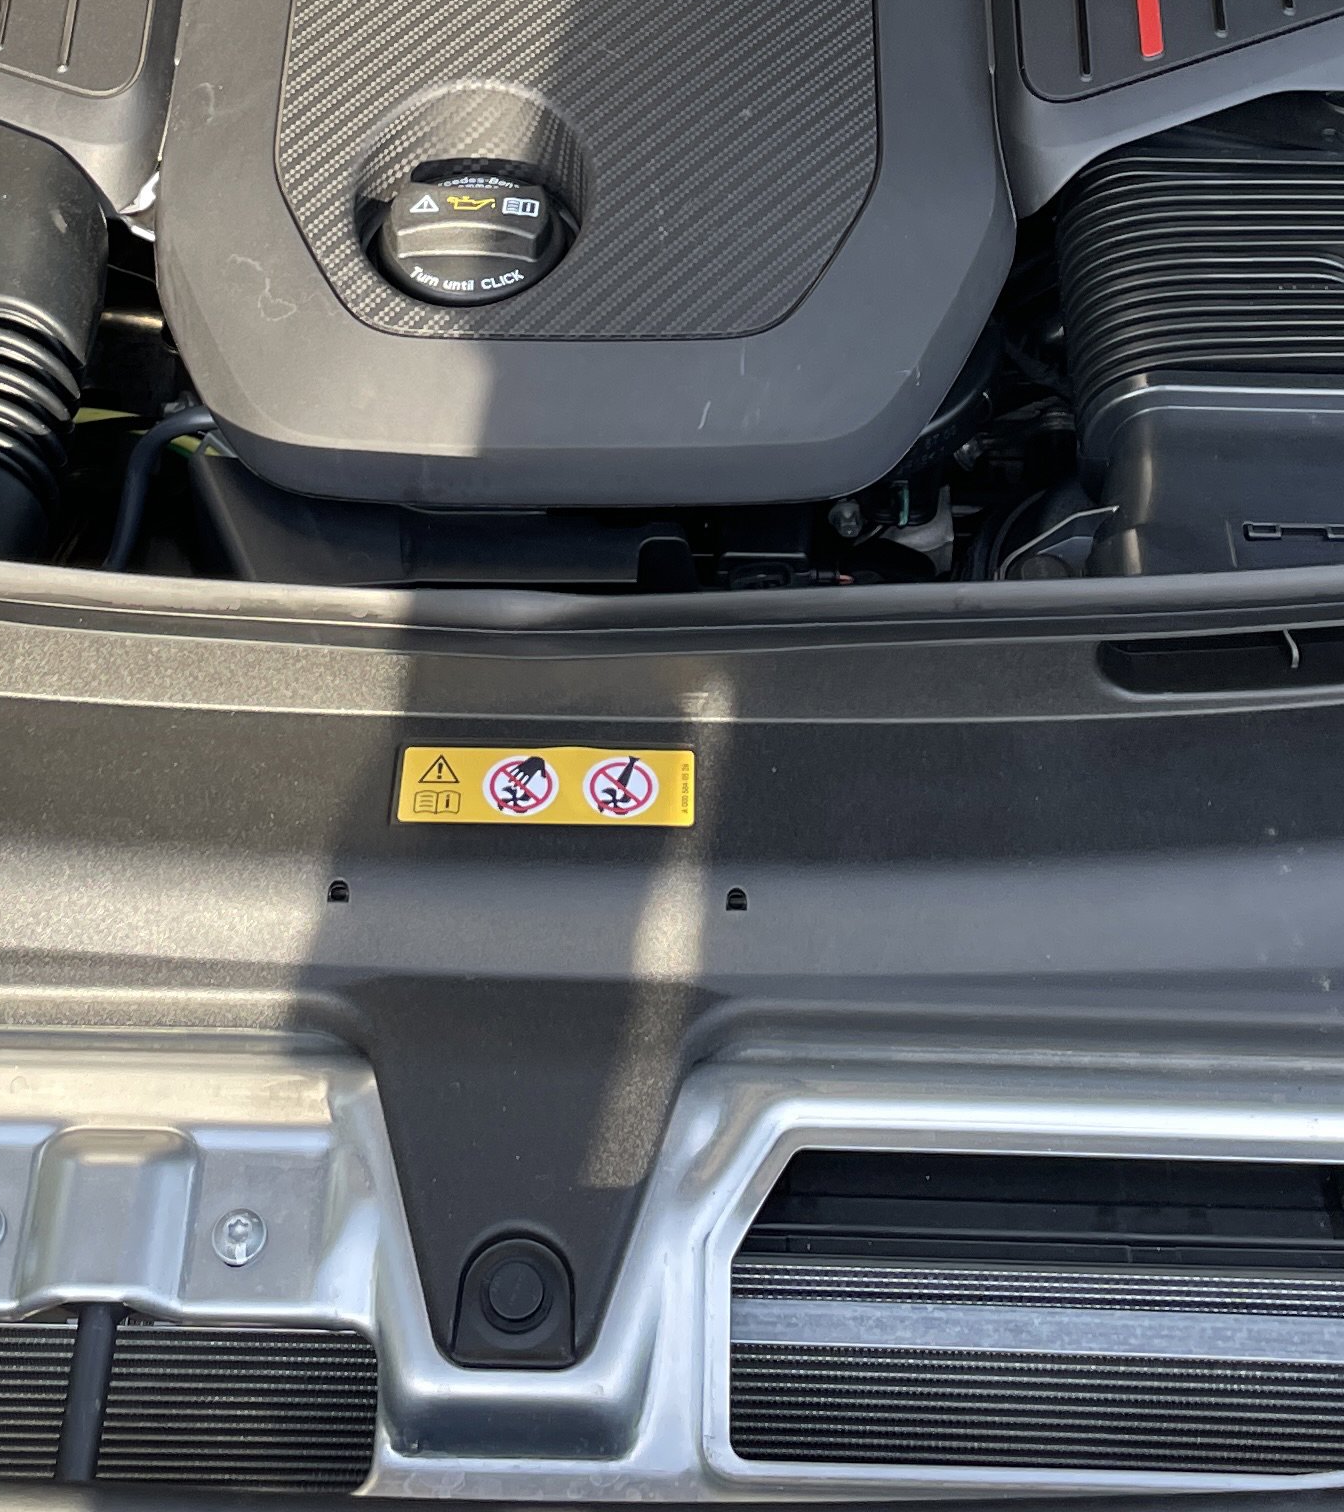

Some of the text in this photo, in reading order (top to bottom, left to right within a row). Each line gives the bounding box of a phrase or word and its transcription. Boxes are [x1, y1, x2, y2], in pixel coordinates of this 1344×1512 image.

[410, 266, 524, 291] Turn until CLICK
